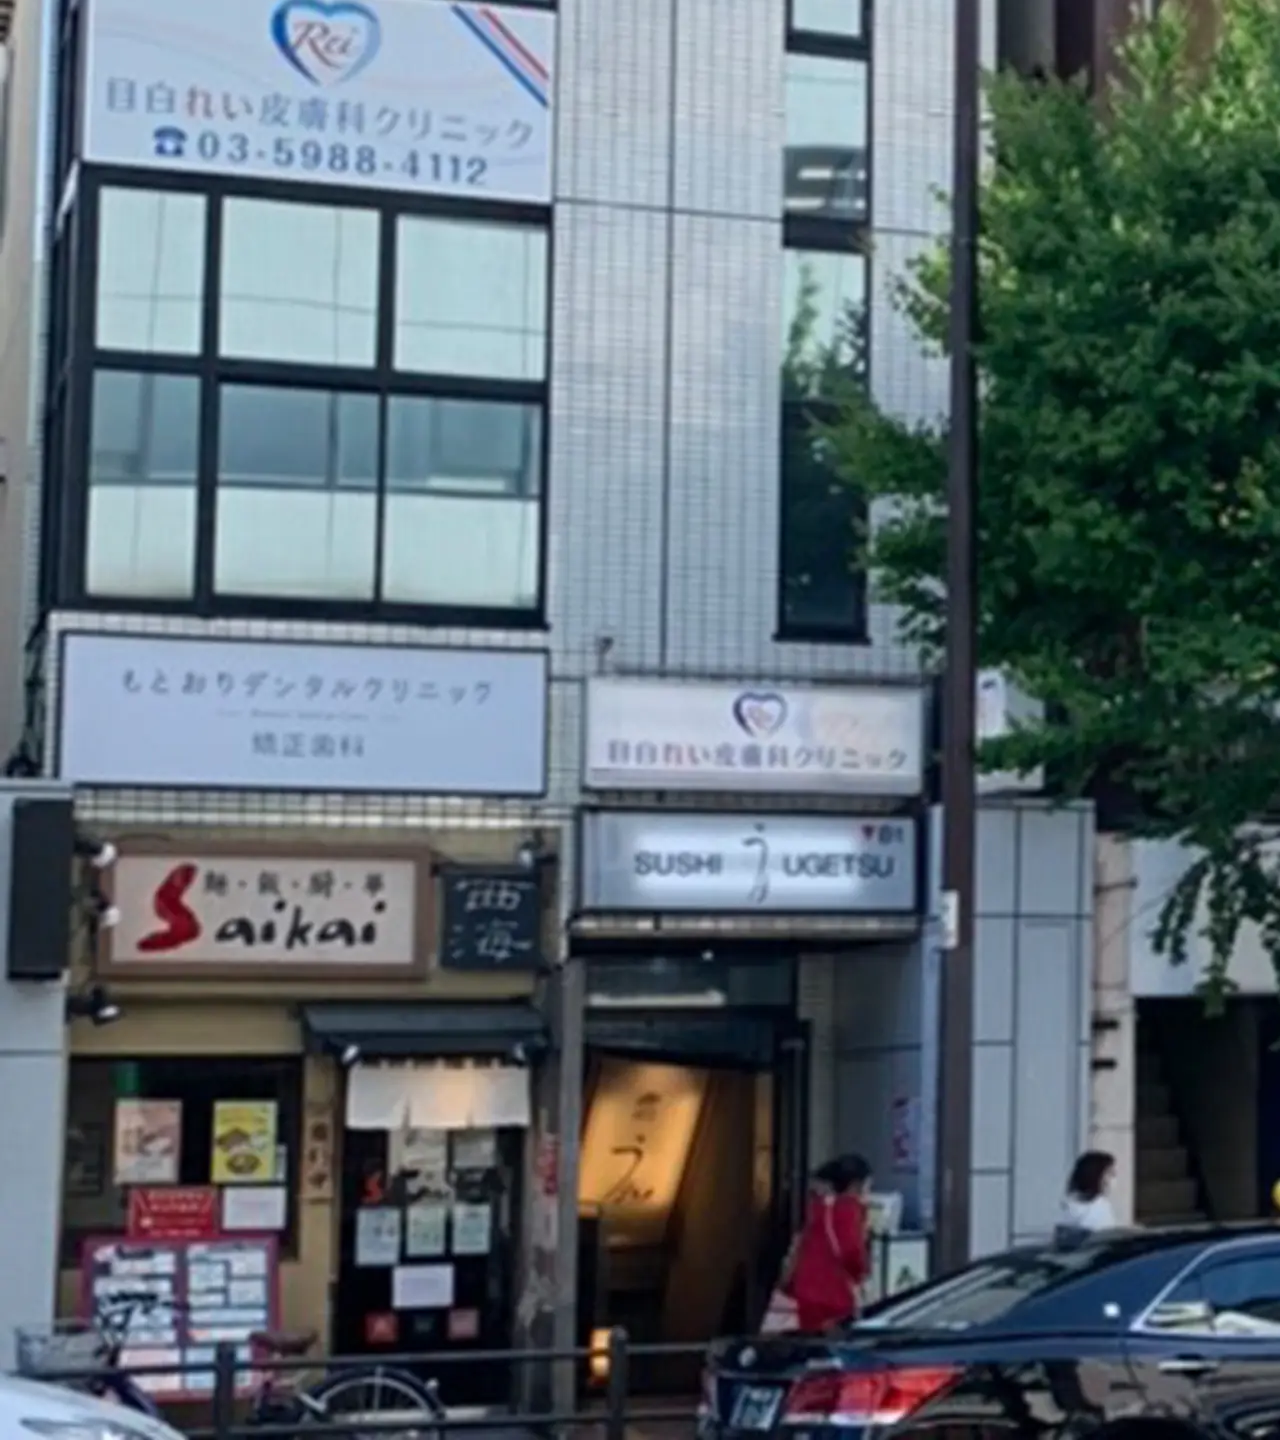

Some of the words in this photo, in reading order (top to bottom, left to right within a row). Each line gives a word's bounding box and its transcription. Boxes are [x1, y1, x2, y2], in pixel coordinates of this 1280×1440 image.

[107, 75, 535, 150] 目白れい皮膚科クリニック
[196, 129, 488, 186] 03-5988-4112
[121, 668, 493, 705] もとおりデンタルクリニック
[634, 851, 723, 876] SUSHI
[782, 852, 896, 879] UGETSU
[135, 862, 387, 952] Saikai
